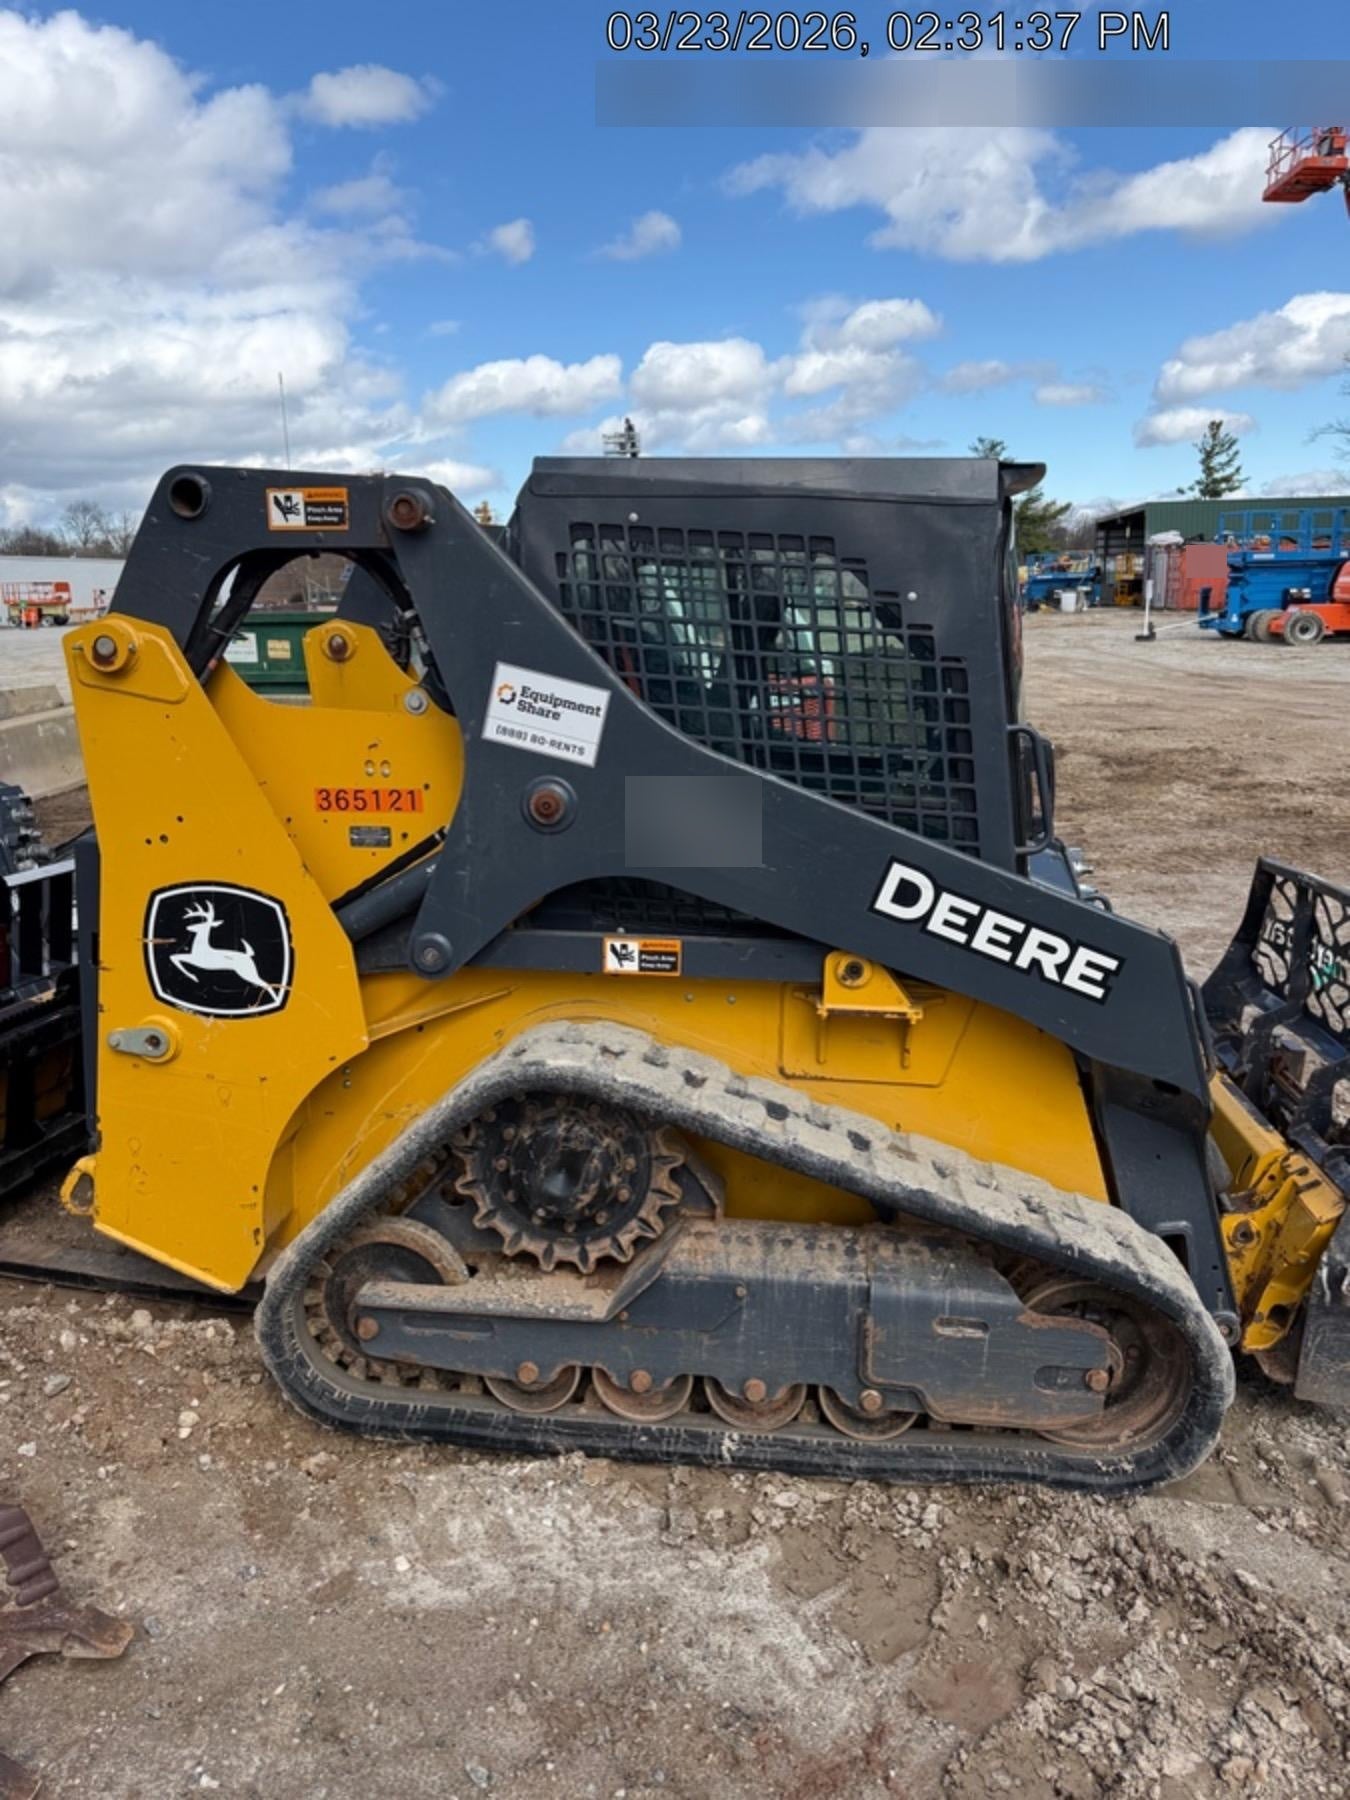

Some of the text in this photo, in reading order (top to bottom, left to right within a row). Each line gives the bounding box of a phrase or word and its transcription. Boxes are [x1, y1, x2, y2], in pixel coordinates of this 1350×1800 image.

[516, 699, 561, 721] Share
[520, 685, 602, 717] Equipment
[495, 724, 528, 741] (888)
[318, 788, 416, 811] 365121
[873, 861, 1120, 1000] DEERE
